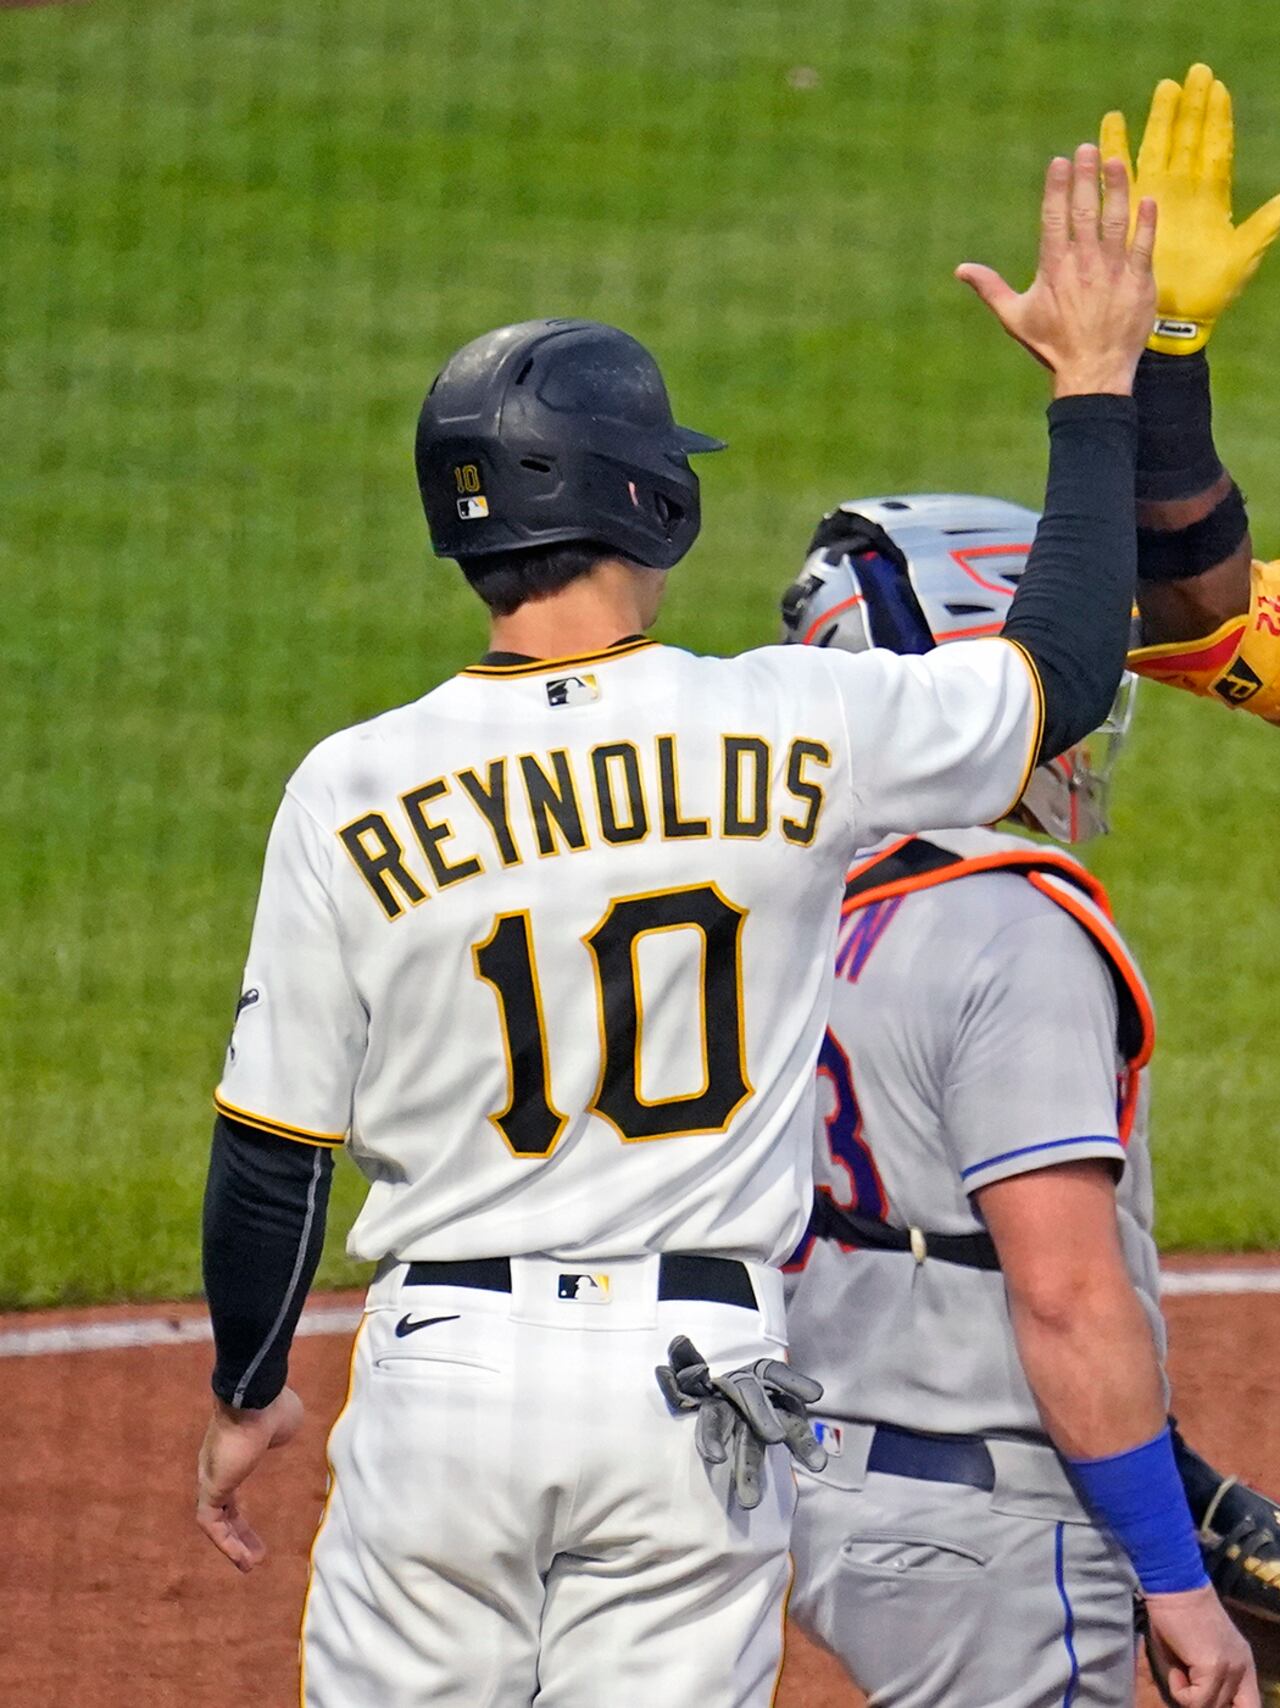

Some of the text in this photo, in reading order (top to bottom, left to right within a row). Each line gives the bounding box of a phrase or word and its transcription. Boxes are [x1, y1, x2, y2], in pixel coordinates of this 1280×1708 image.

[455, 465, 480, 493] 10
[336, 733, 833, 923] REYNOLDS
[470, 880, 756, 1159] 10
